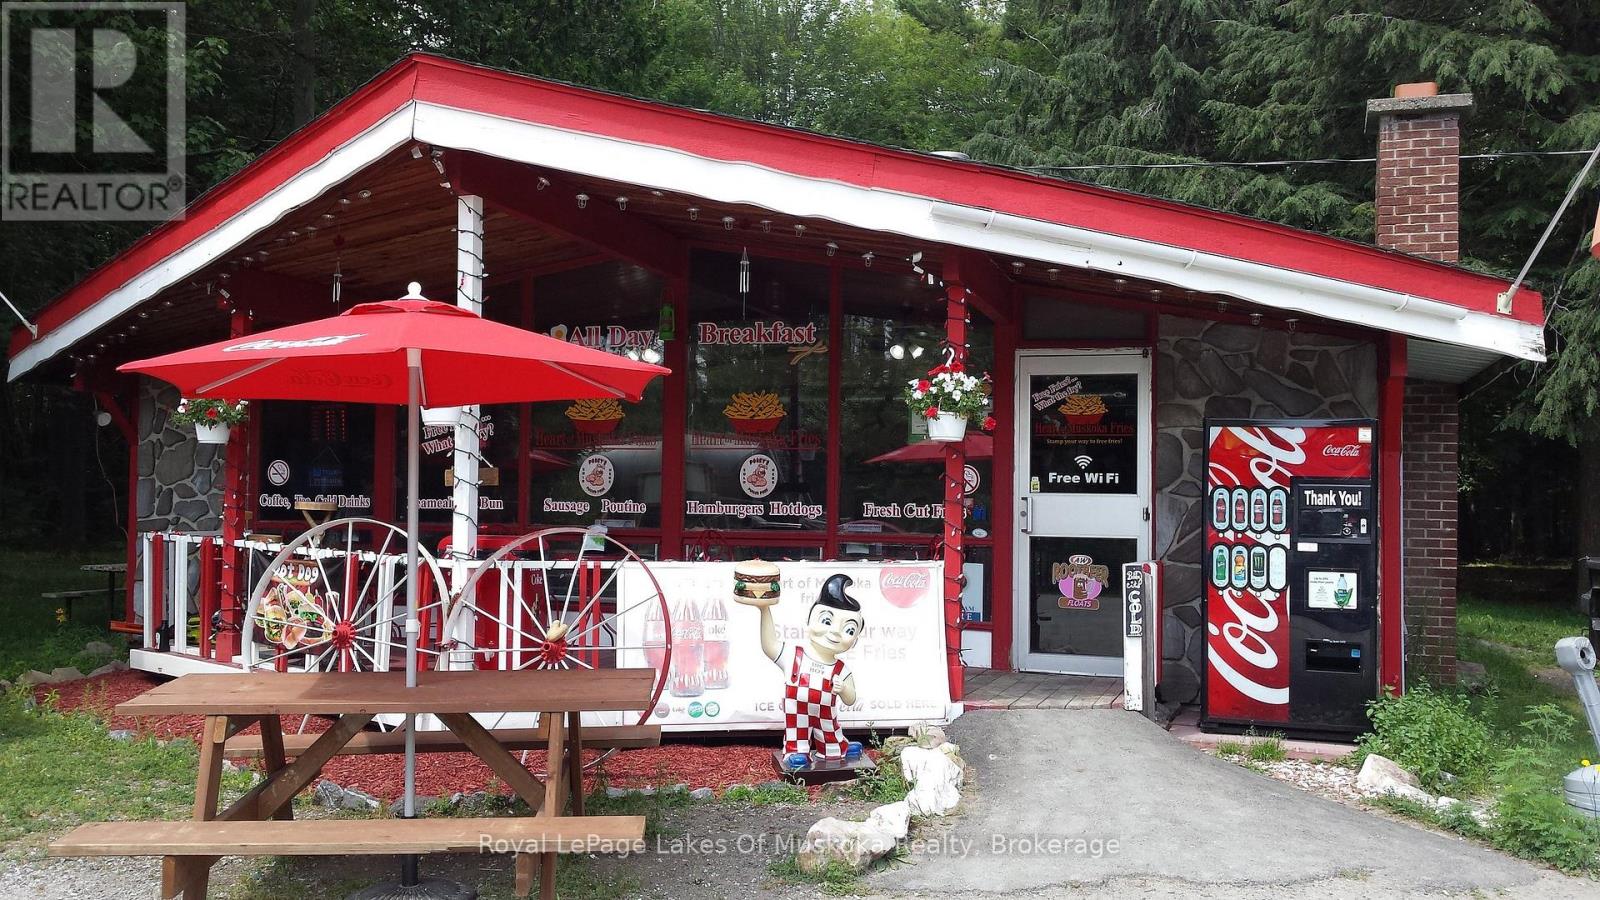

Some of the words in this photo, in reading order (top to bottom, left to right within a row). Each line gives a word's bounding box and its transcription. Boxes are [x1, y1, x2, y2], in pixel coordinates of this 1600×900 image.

[569, 325, 601, 348] All
[606, 325, 653, 349] Day
[698, 322, 817, 345] Breakfast
[423, 425, 449, 440] Free
[1322, 445, 1360, 459] Coca-Cola
[1048, 472, 1081, 483] Free
[259, 494, 291, 510] Coffee,
[338, 494, 370, 508] Drinks
[479, 496, 504, 510] Bun
[1303, 489, 1339, 506] Thank
[1339, 489, 1362, 506] You!
[543, 498, 590, 515] Sausage
[601, 498, 647, 514] Poutine
[686, 500, 765, 519] Hamburgers
[769, 501, 823, 520] Hotdogs
[863, 502, 901, 518] Fresh
[903, 503, 931, 519] Cut
[797, 577, 811, 589] of
[1066, 599, 1092, 608] FLOATS
[754, 702, 776, 713] ICE
[869, 700, 903, 710] SOLD
